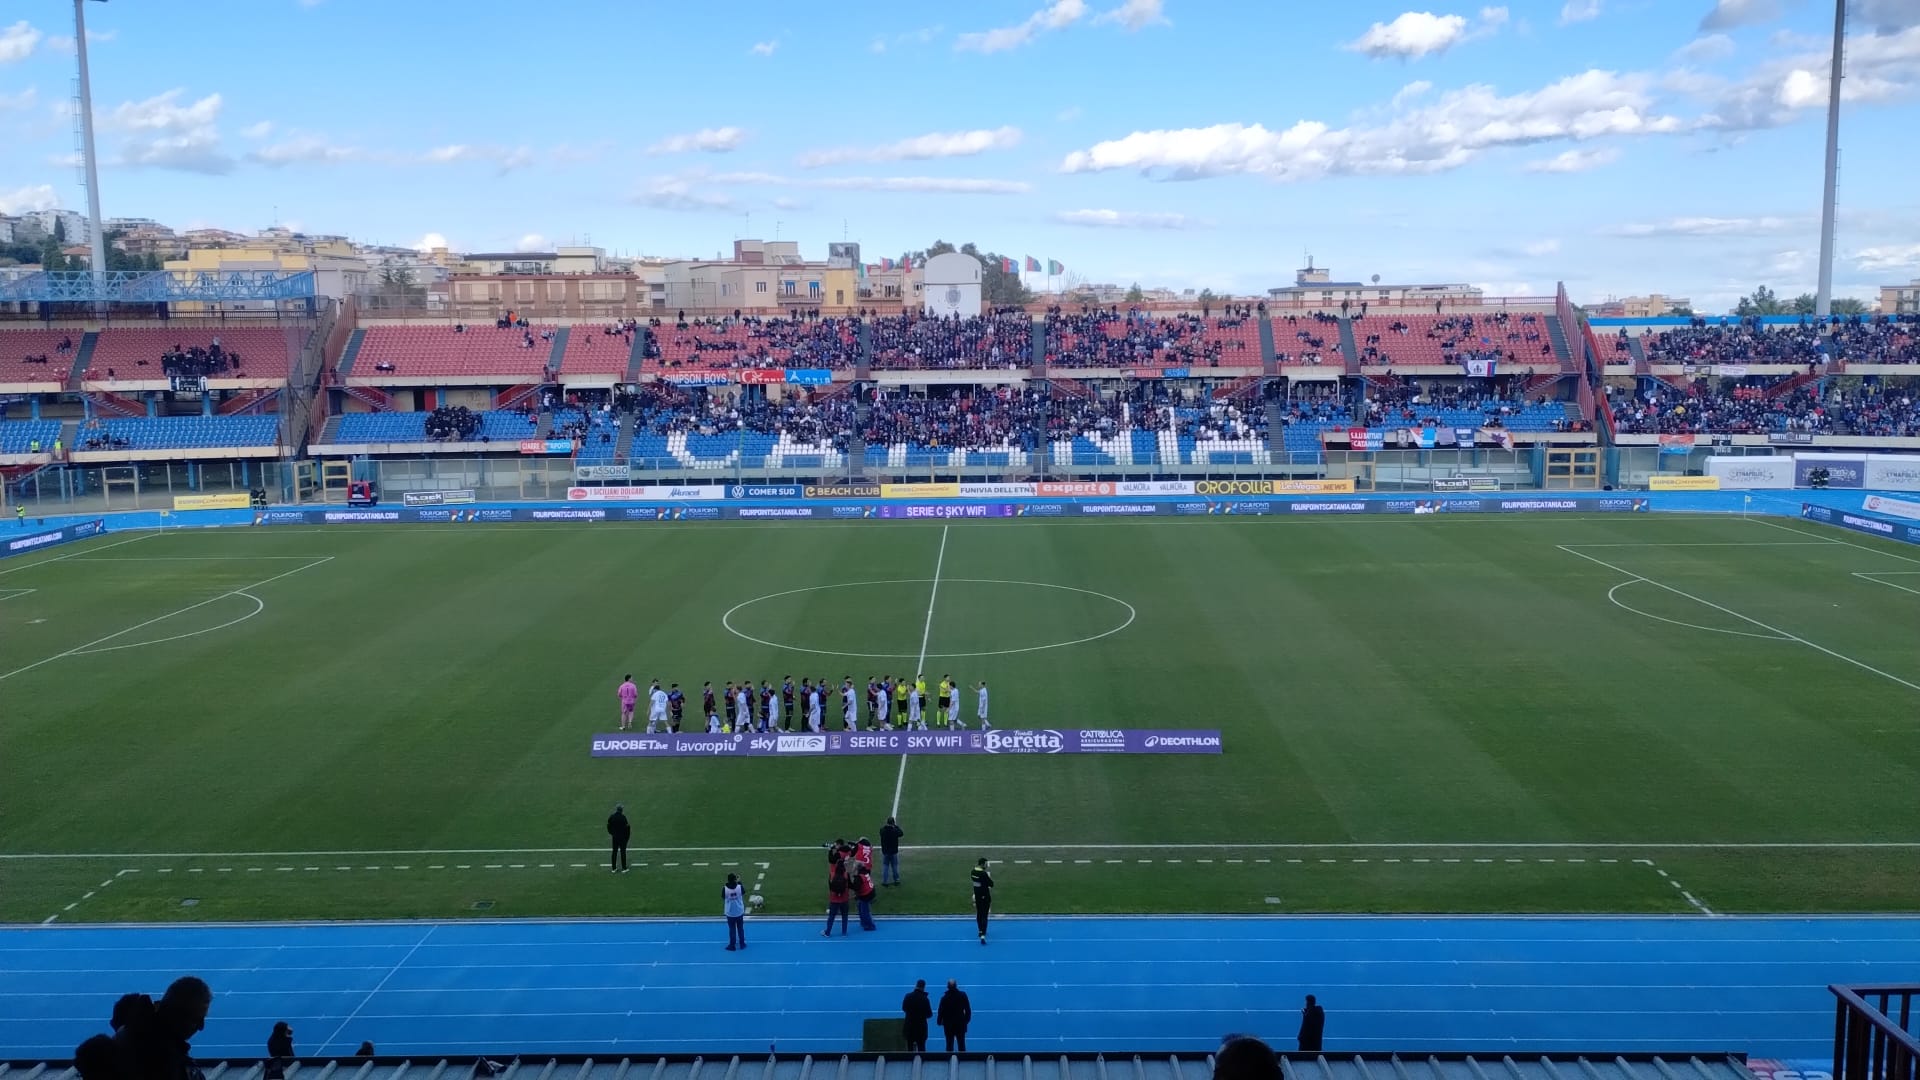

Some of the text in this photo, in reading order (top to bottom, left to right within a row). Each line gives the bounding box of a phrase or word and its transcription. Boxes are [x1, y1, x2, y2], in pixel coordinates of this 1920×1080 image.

[664, 373, 727, 385] SIMPSON BOYS
[748, 488, 795, 496] COMER SUD
[817, 487, 850, 496] BEACH
[853, 487, 880, 496] CLUB
[1043, 483, 1097, 494] expert
[907, 506, 987, 517] SERIE C SKY WIFI
[750, 738, 805, 751] sky wifi
[850, 737, 961, 747] SERIE C SKY WIFI
[986, 734, 1061, 749] Beretta
[1160, 737, 1219, 746] DECATHLON
